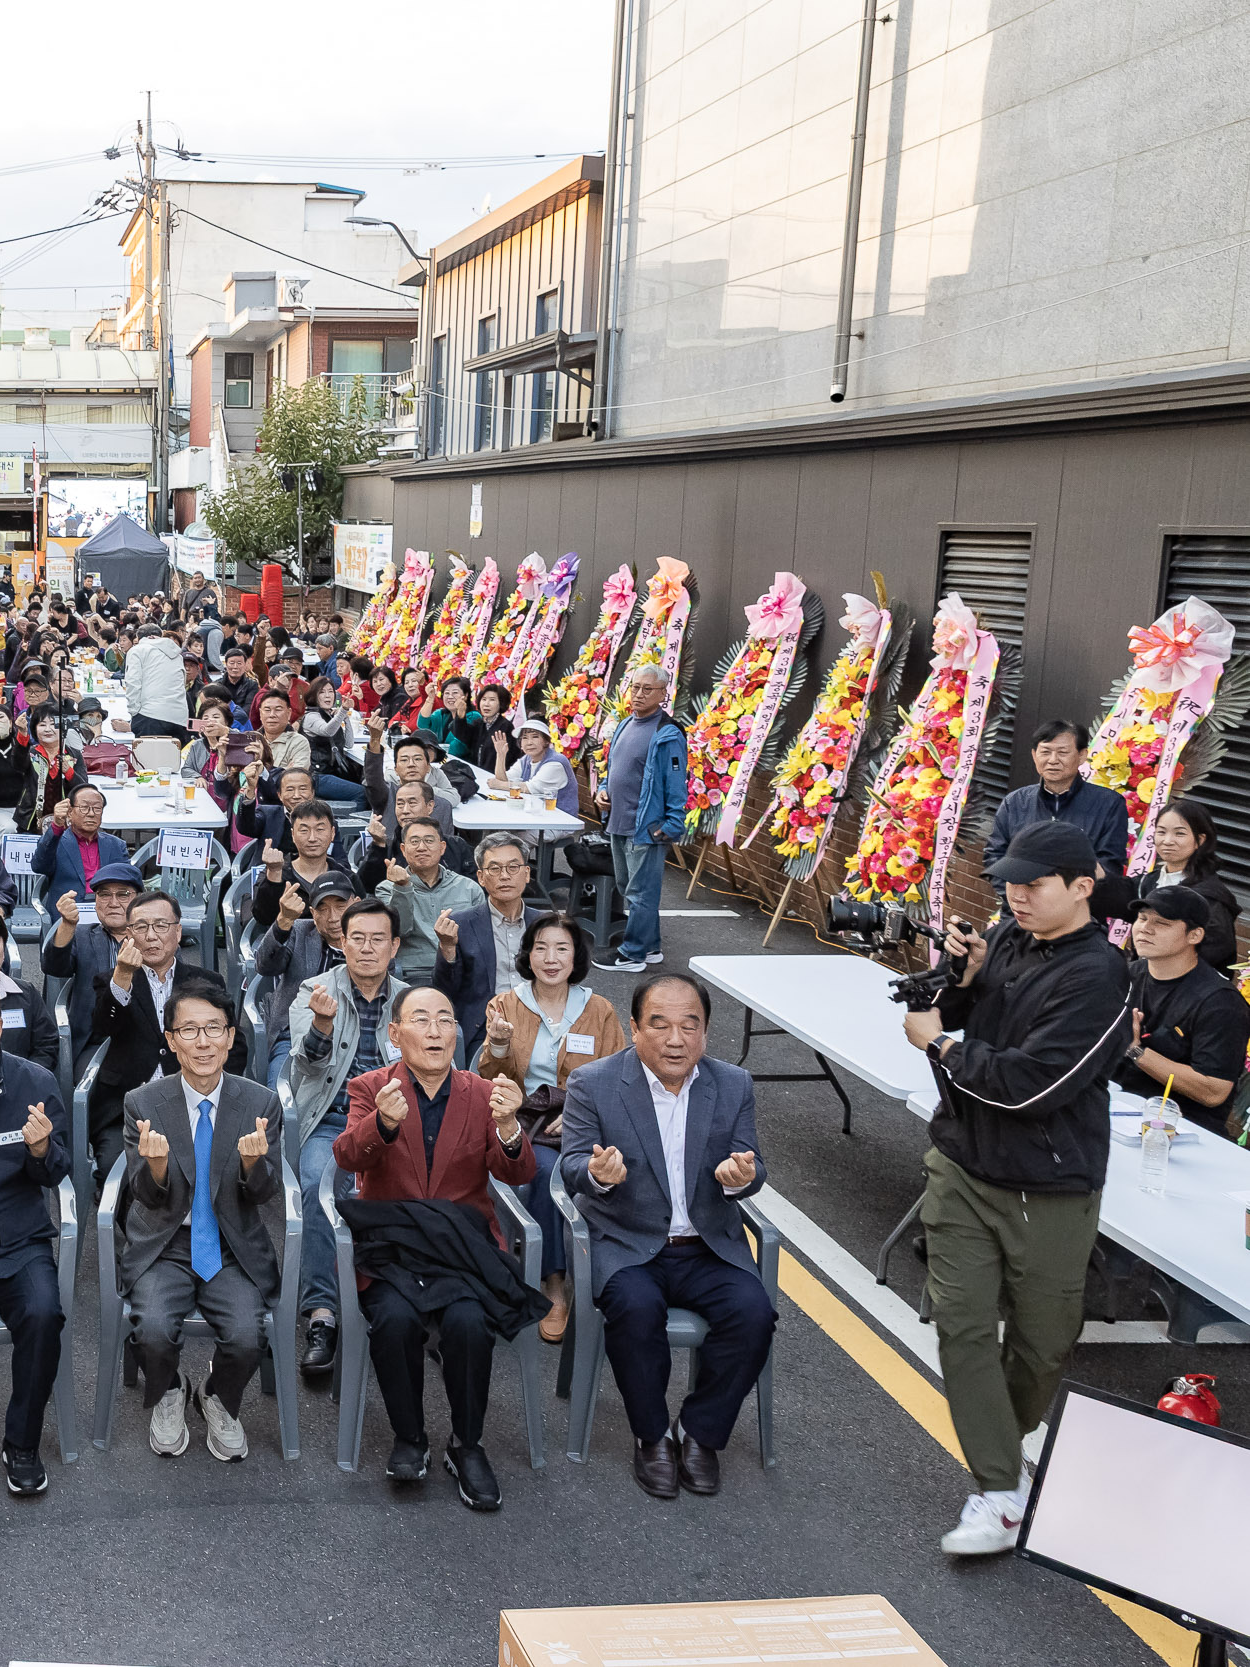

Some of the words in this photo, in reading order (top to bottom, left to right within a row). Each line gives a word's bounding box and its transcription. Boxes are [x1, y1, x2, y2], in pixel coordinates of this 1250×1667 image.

[672, 617, 684, 633] 축
[774, 646, 794, 677] 제3회
[972, 675, 991, 690] 축
[754, 681, 786, 743] 중곡제일시장
[965, 695, 986, 738] 제3회
[1161, 719, 1188, 769] 제3회
[941, 744, 978, 832] 중곡제일시장
[929, 836, 954, 925] 황금맥주축제
